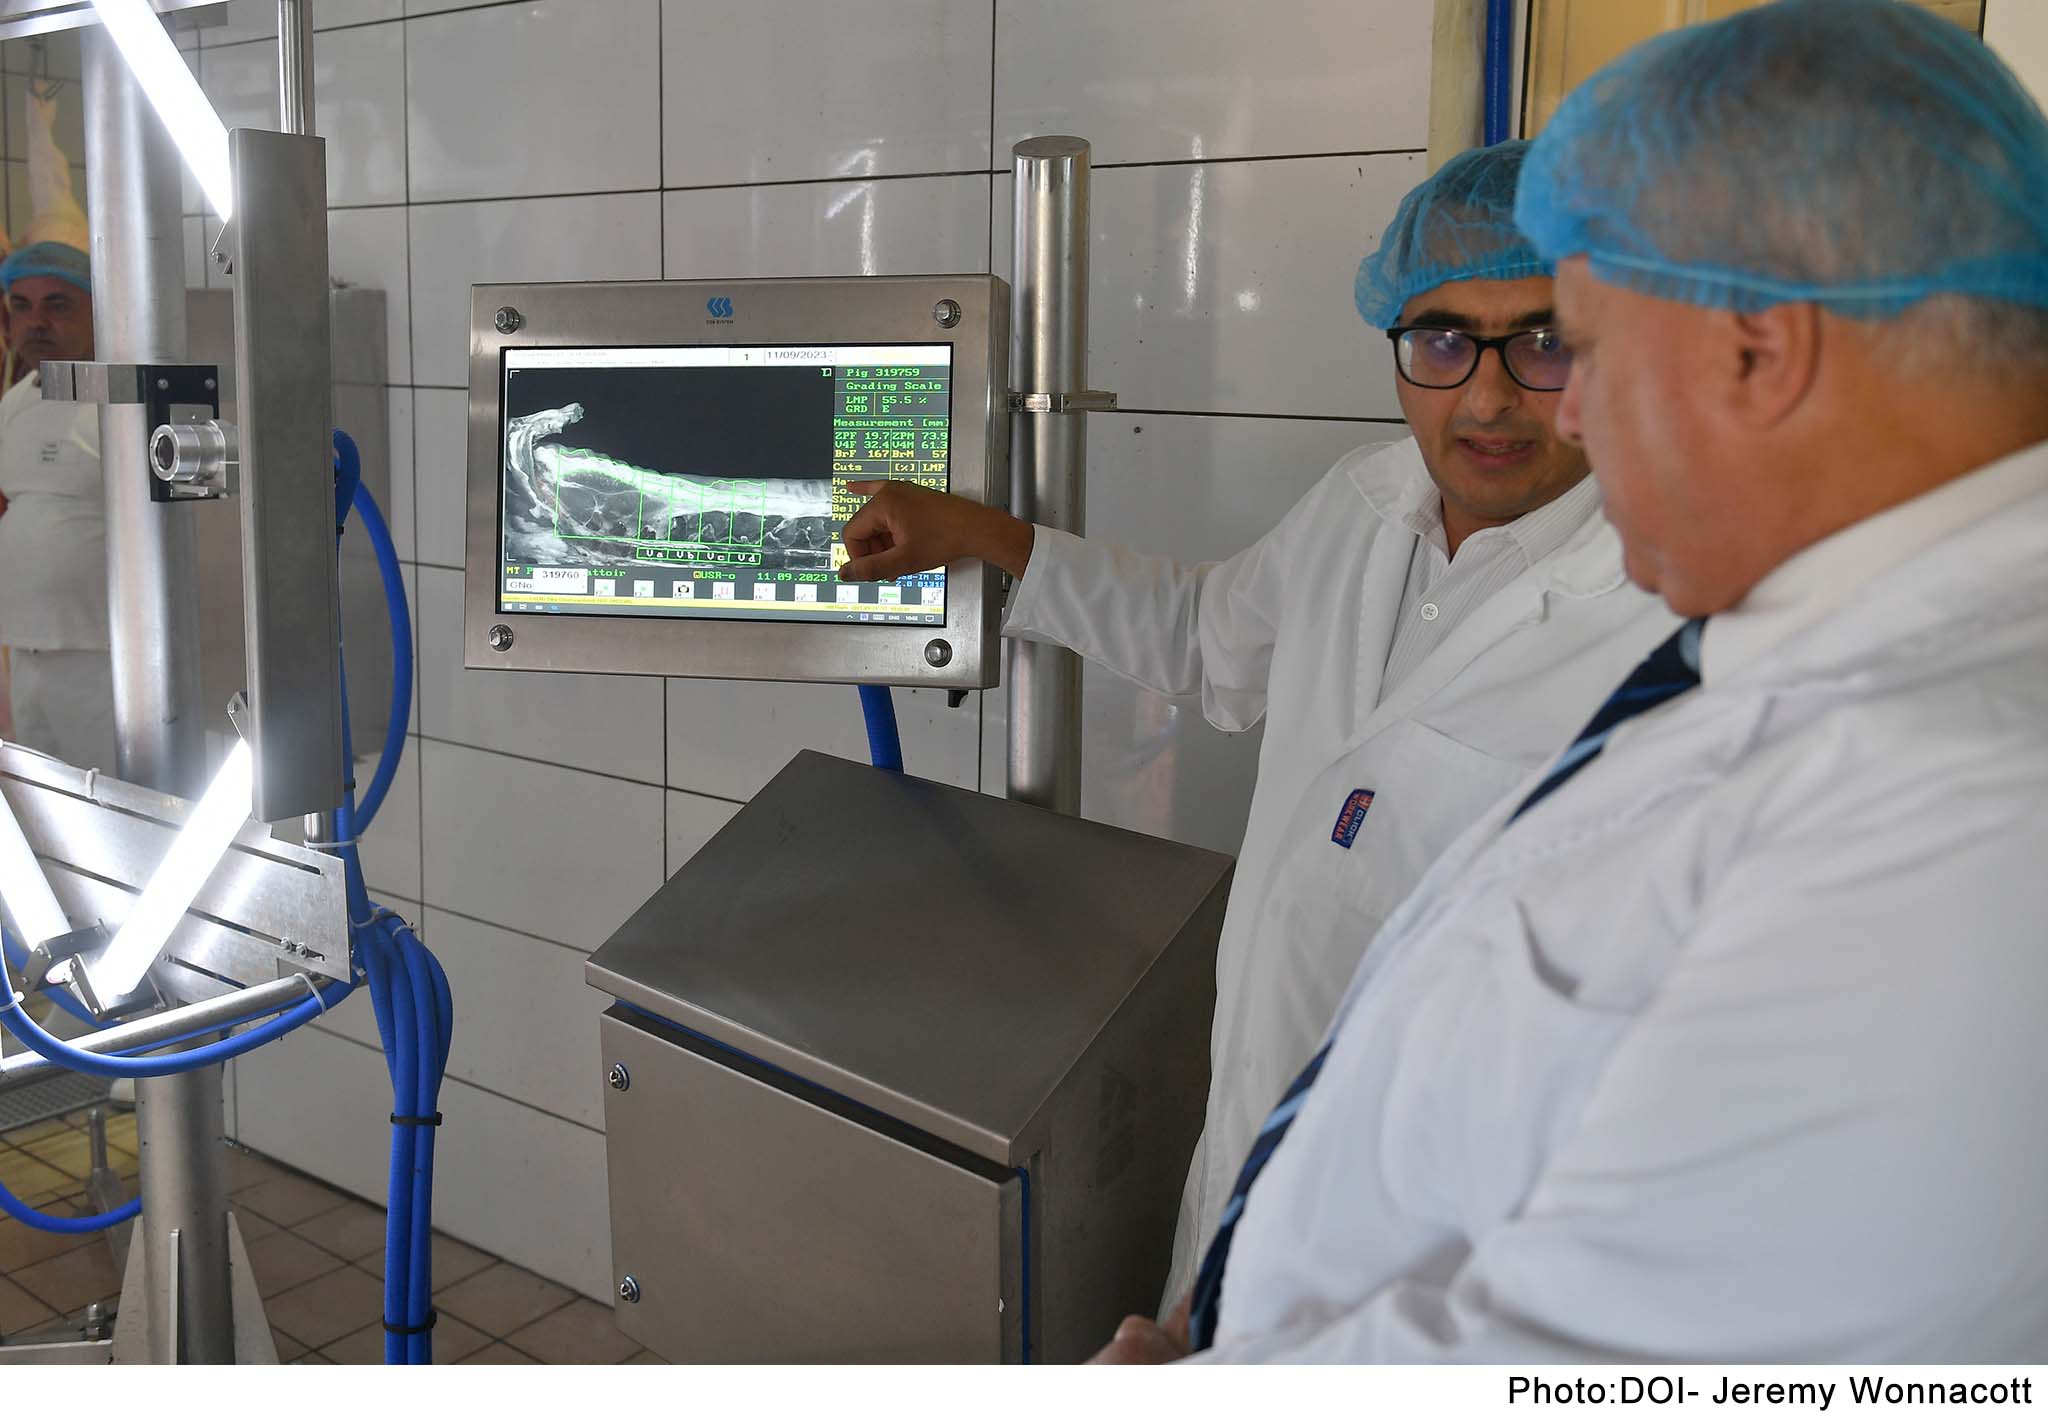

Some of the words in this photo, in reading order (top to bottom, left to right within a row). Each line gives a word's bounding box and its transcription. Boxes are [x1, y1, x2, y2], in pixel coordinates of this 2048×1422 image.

[767, 351, 827, 360] 11/09/2023
[846, 369, 868, 378] Pig
[875, 368, 920, 377] 319759
[846, 382, 897, 391] Grading
[904, 382, 942, 390] Scale
[845, 396, 868, 404] LMP
[881, 396, 912, 404] 55.5
[845, 405, 868, 413] GRD
[881, 405, 890, 413] E
[833, 418, 914, 427] Measurement
[834, 432, 857, 440] ZPF
[864, 432, 890, 440] 19.7
[892, 432, 915, 440] ZPM
[921, 432, 948, 440] 73.9
[863, 441, 890, 449] 32.4
[921, 441, 948, 449] 61.3
[834, 450, 857, 458] BrF
[867, 450, 890, 458] 167
[892, 450, 914, 458] BrM
[931, 450, 948, 458] 57
[832, 463, 863, 471] Cuts
[922, 464, 945, 472] LMP
[832, 477, 855, 486] Ha
[921, 478, 947, 487] 69.3
[506, 566, 521, 575] MT
[542, 571, 580, 579] 319760
[757, 572, 828, 582] 11.09.2023
[509, 581, 533, 589] GNo
[1347, 809, 1364, 839] CLICK
